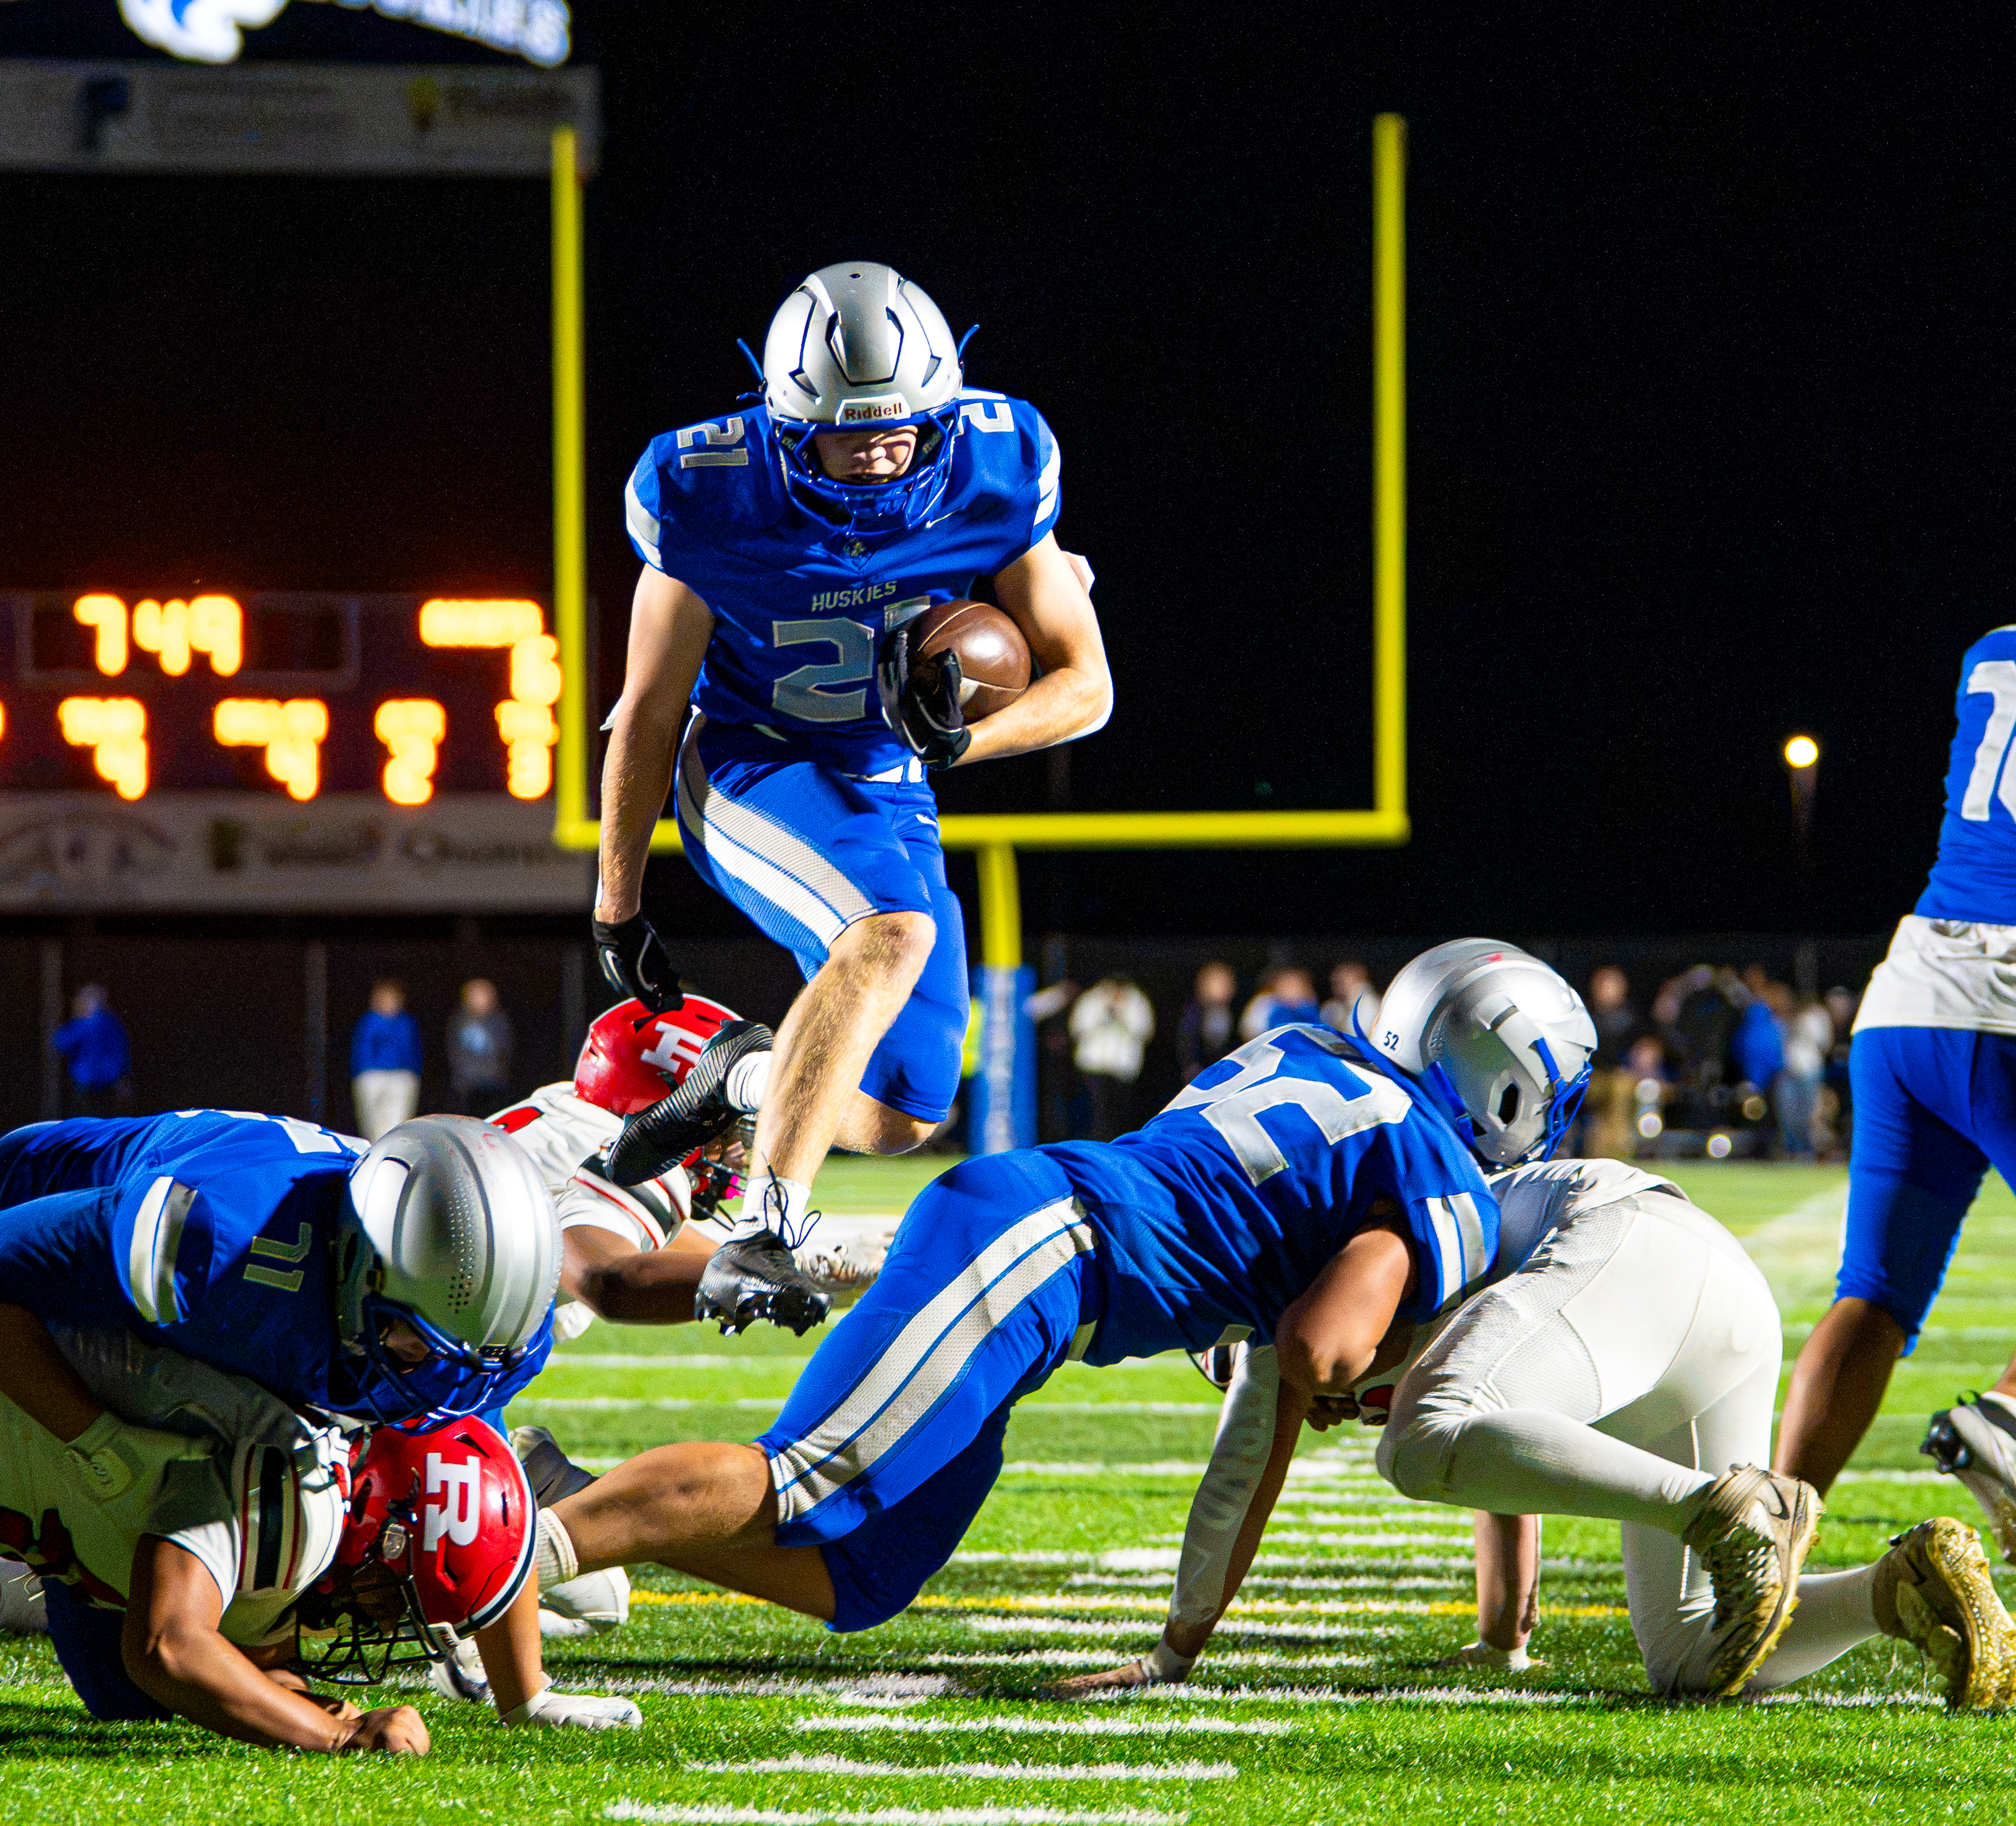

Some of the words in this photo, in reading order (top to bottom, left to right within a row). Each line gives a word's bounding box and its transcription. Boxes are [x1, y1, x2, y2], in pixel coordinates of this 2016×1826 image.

[844, 403, 903, 421] Riddell
[677, 417, 749, 469] 21
[811, 580, 898, 612] HUSKIES
[1384, 1031, 1399, 1051] 52
[243, 1222, 312, 1292] 71
[423, 1452, 481, 1553] R
